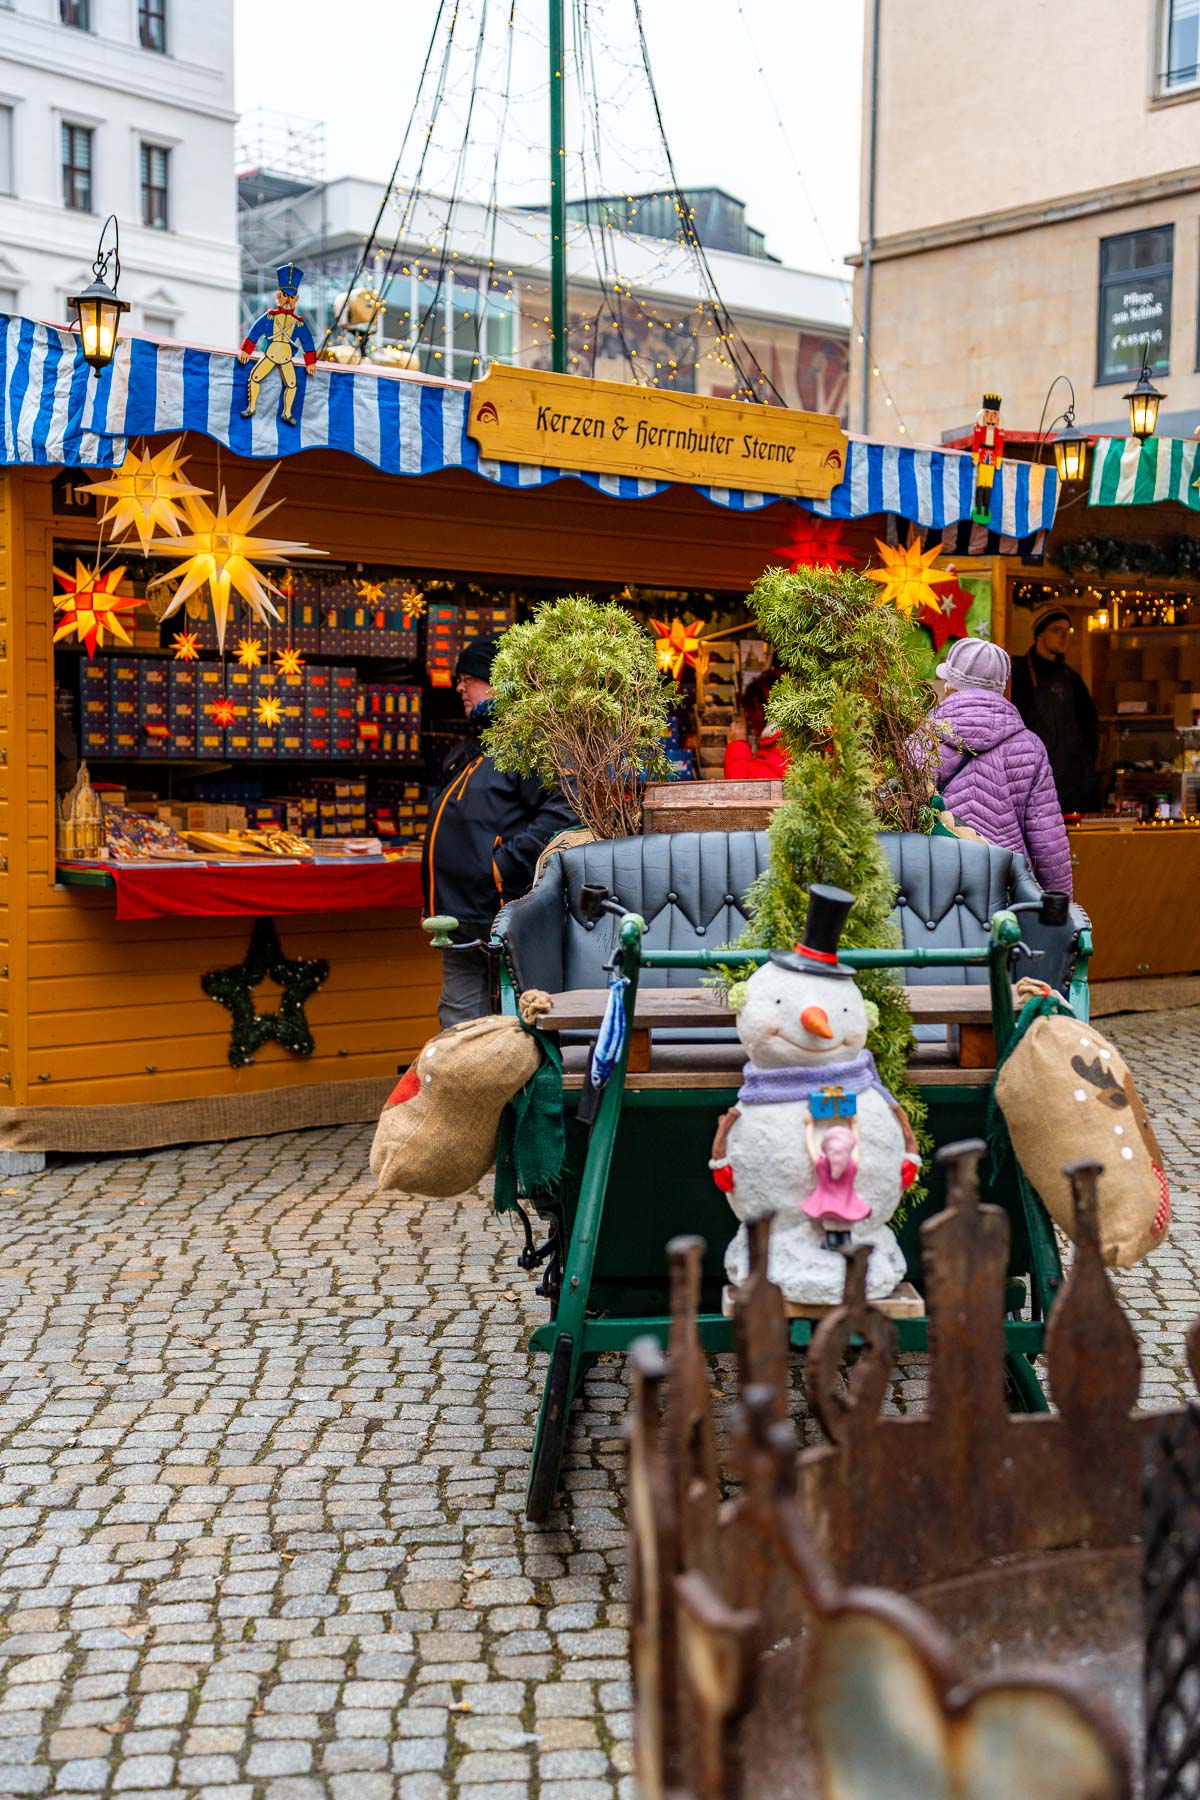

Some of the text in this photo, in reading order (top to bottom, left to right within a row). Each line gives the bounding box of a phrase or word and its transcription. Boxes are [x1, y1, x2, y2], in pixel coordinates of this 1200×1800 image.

[535, 405, 797, 464] Kerzen & Herrnhuter Sterne
